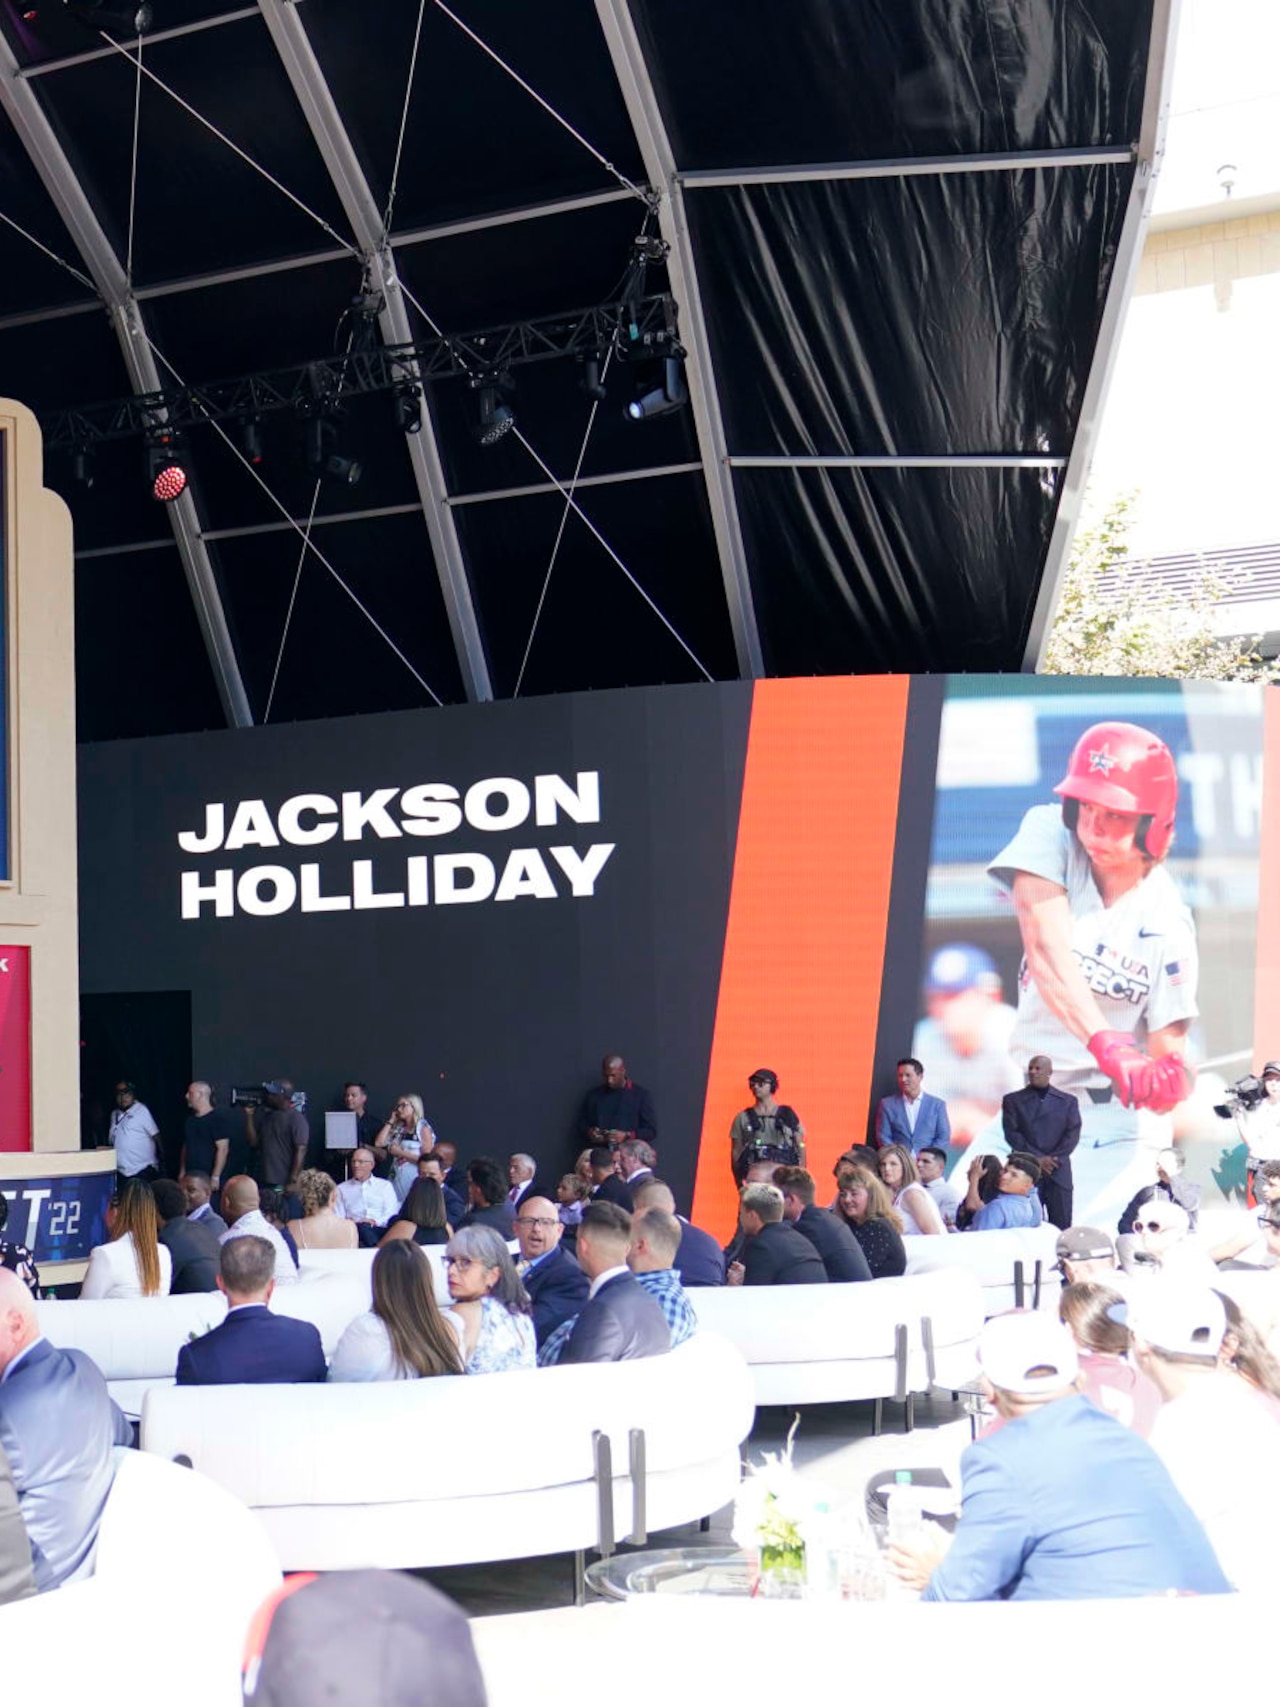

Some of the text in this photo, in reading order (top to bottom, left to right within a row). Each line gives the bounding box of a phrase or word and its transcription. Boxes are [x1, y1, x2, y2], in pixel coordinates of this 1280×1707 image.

[178, 771, 601, 853] JACKSON
[181, 843, 616, 920] HOLLIDAY
[47, 1200, 81, 1236] '22
